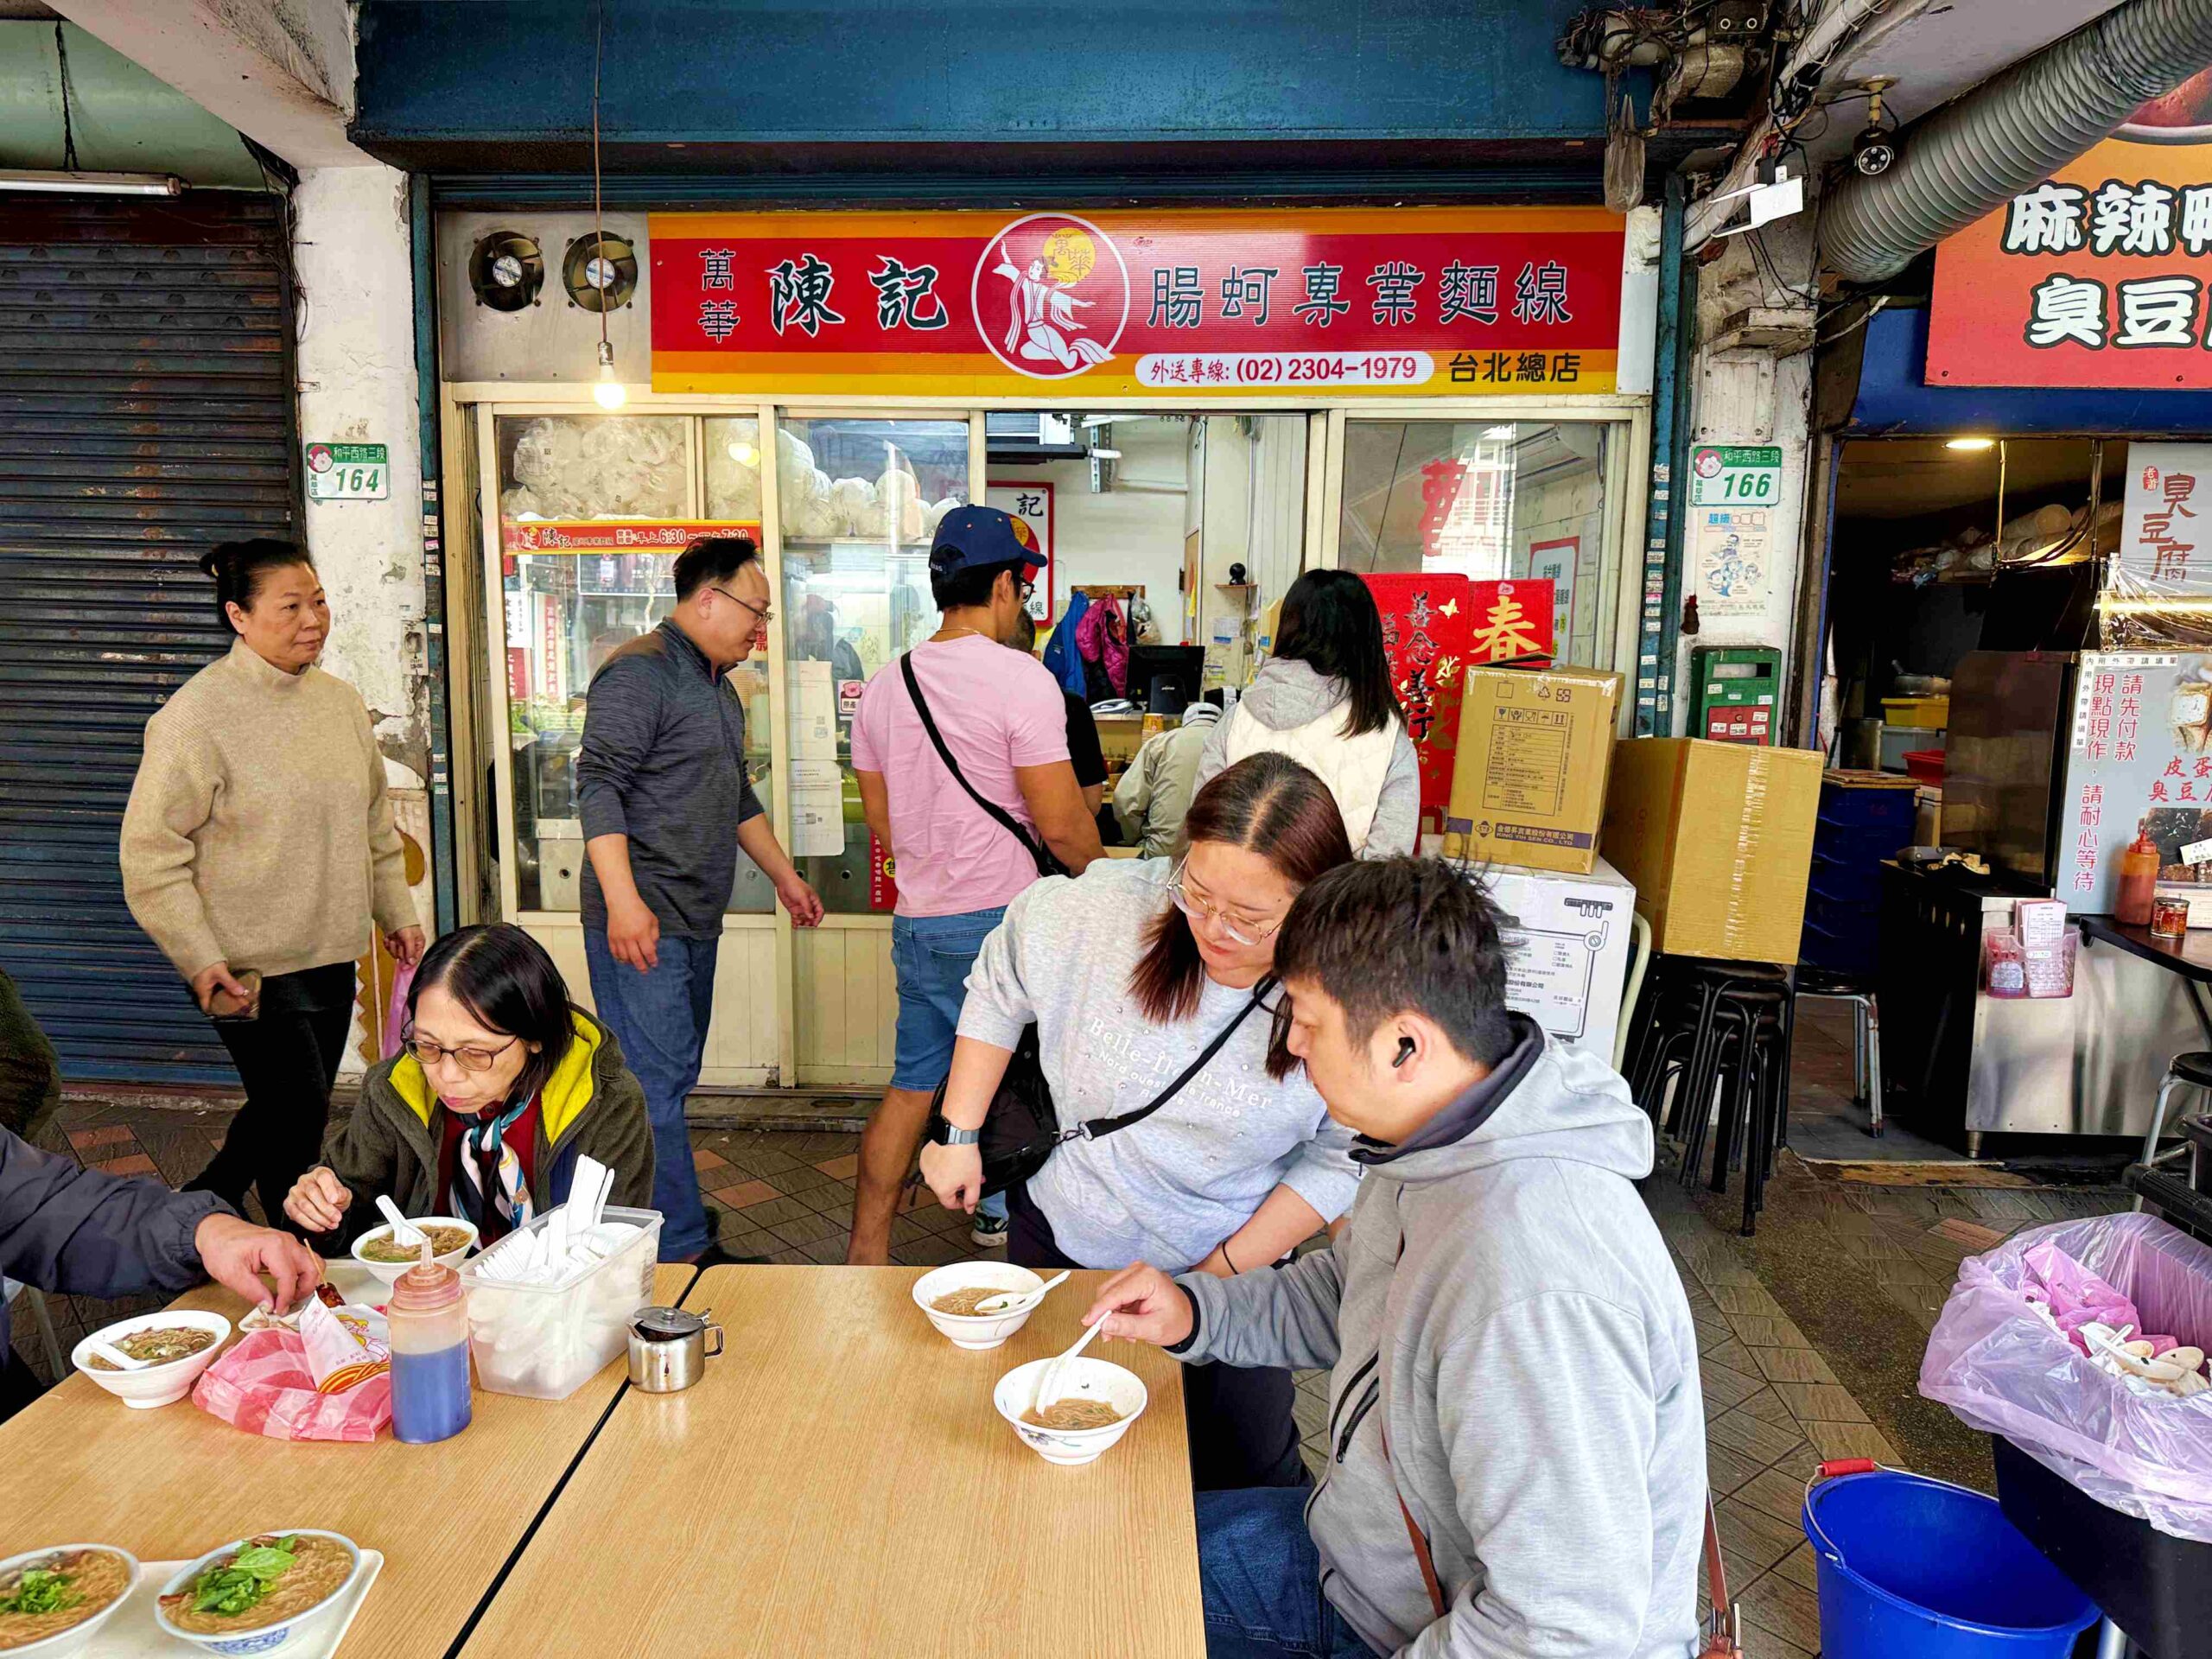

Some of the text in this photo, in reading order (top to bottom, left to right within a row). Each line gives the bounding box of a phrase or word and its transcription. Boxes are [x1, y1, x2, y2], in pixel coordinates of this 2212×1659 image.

[698, 248, 1573, 344] 萬華 陳記 腸蚵專業麵線
[2029, 277, 2212, 347] 臭豆
[1151, 354, 1418, 384] 外送專線: (02) 2304-1979
[1448, 352, 1581, 384] 台北總店
[335, 468, 379, 492] 164
[1723, 473, 1772, 499] 166
[1016, 493, 1044, 517] 記
[2139, 473, 2198, 582] 臭豆腐
[1470, 595, 1541, 662] 春
[2114, 674, 2144, 761] 請先付款
[1098, 1052, 1128, 1074] Nord
